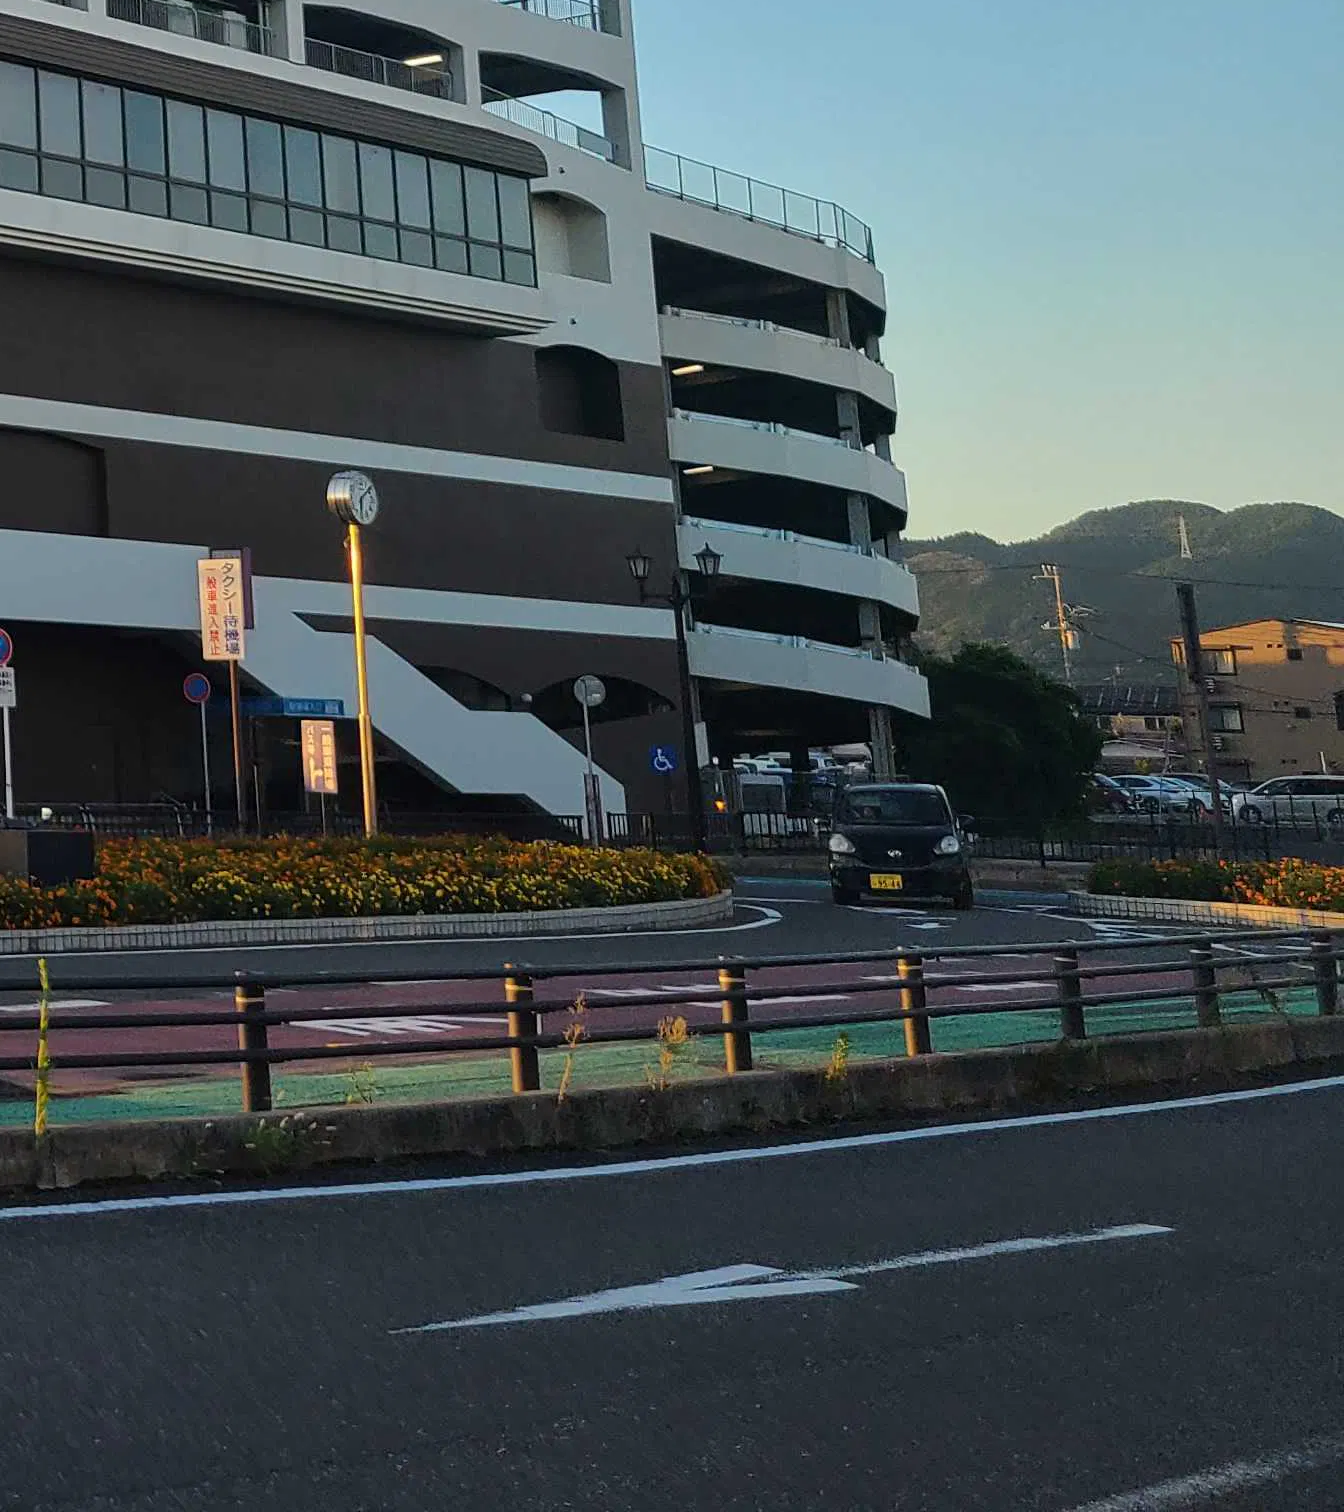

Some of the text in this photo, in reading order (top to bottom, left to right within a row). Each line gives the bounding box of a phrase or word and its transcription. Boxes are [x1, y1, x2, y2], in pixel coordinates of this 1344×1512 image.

[221, 562, 240, 655] タクシー待機場
